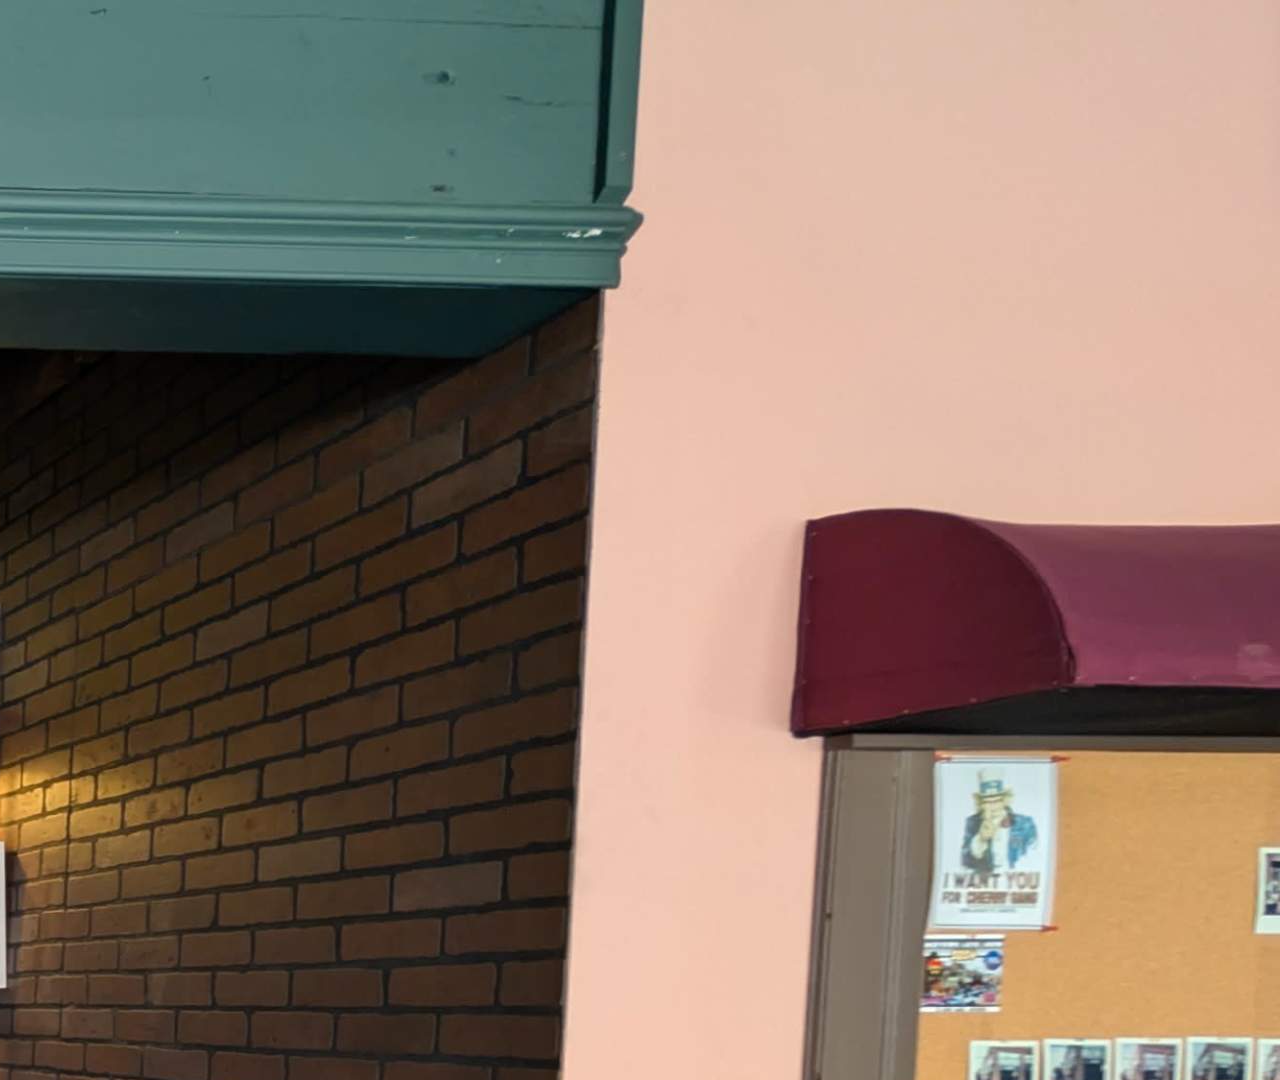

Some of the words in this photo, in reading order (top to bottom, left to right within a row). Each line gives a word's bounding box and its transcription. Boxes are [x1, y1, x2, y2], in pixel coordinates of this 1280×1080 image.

[953, 872, 1001, 889] WANT
[1006, 871, 1040, 889] YOU
[942, 891, 961, 904] FOR
[966, 891, 1008, 905] CHERRY
